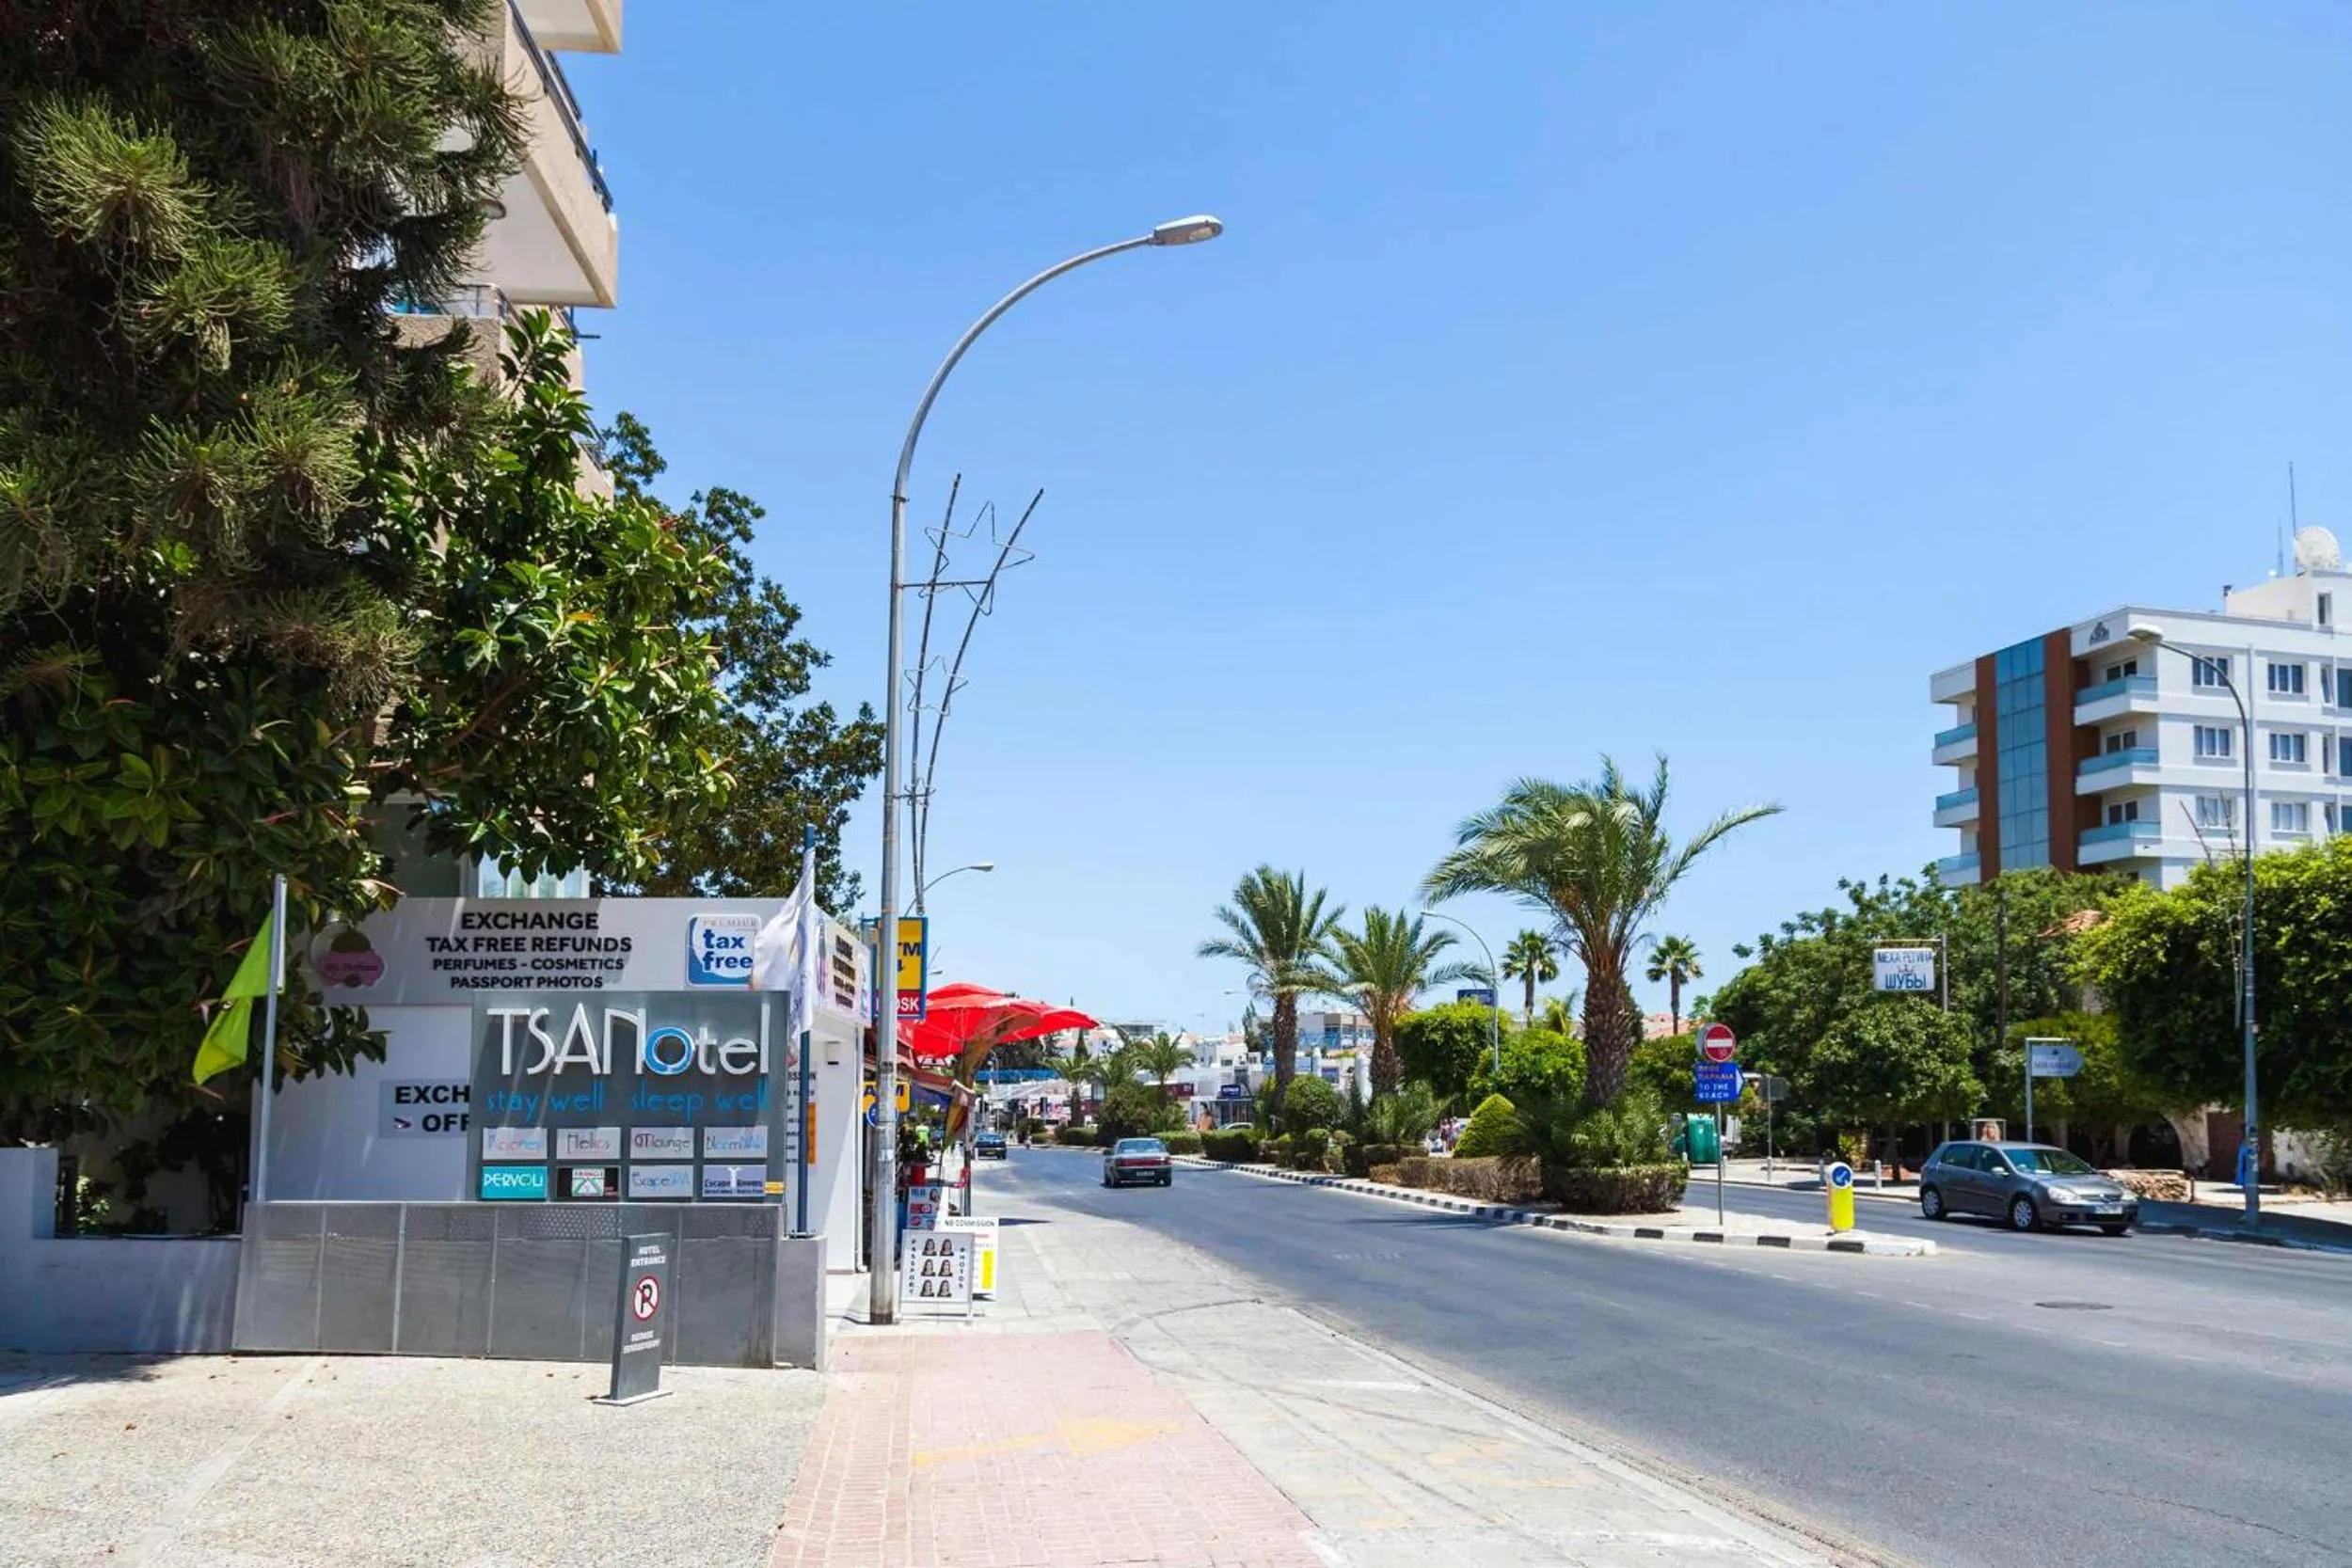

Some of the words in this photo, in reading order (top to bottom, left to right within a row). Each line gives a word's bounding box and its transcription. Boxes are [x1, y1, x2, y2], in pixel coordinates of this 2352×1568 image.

[461, 911, 599, 929] EXCHANGE
[425, 937, 469, 952] TAX
[473, 937, 526, 952] FREE
[532, 937, 633, 952] REFUNDS
[703, 929, 745, 949] tax
[433, 958, 516, 971] PERFUMES
[531, 958, 624, 971] COSMETICS
[702, 951, 753, 971] free
[451, 975, 533, 989] PASSPORT
[537, 975, 603, 988] PHOTOS
[1885, 973, 1927, 989] ШУБЫ
[395, 1085, 470, 1104] EXCH
[486, 1088, 539, 1122] stay
[551, 1079, 603, 1112] well
[630, 1079, 704, 1122] sleep
[716, 1079, 770, 1112] well
